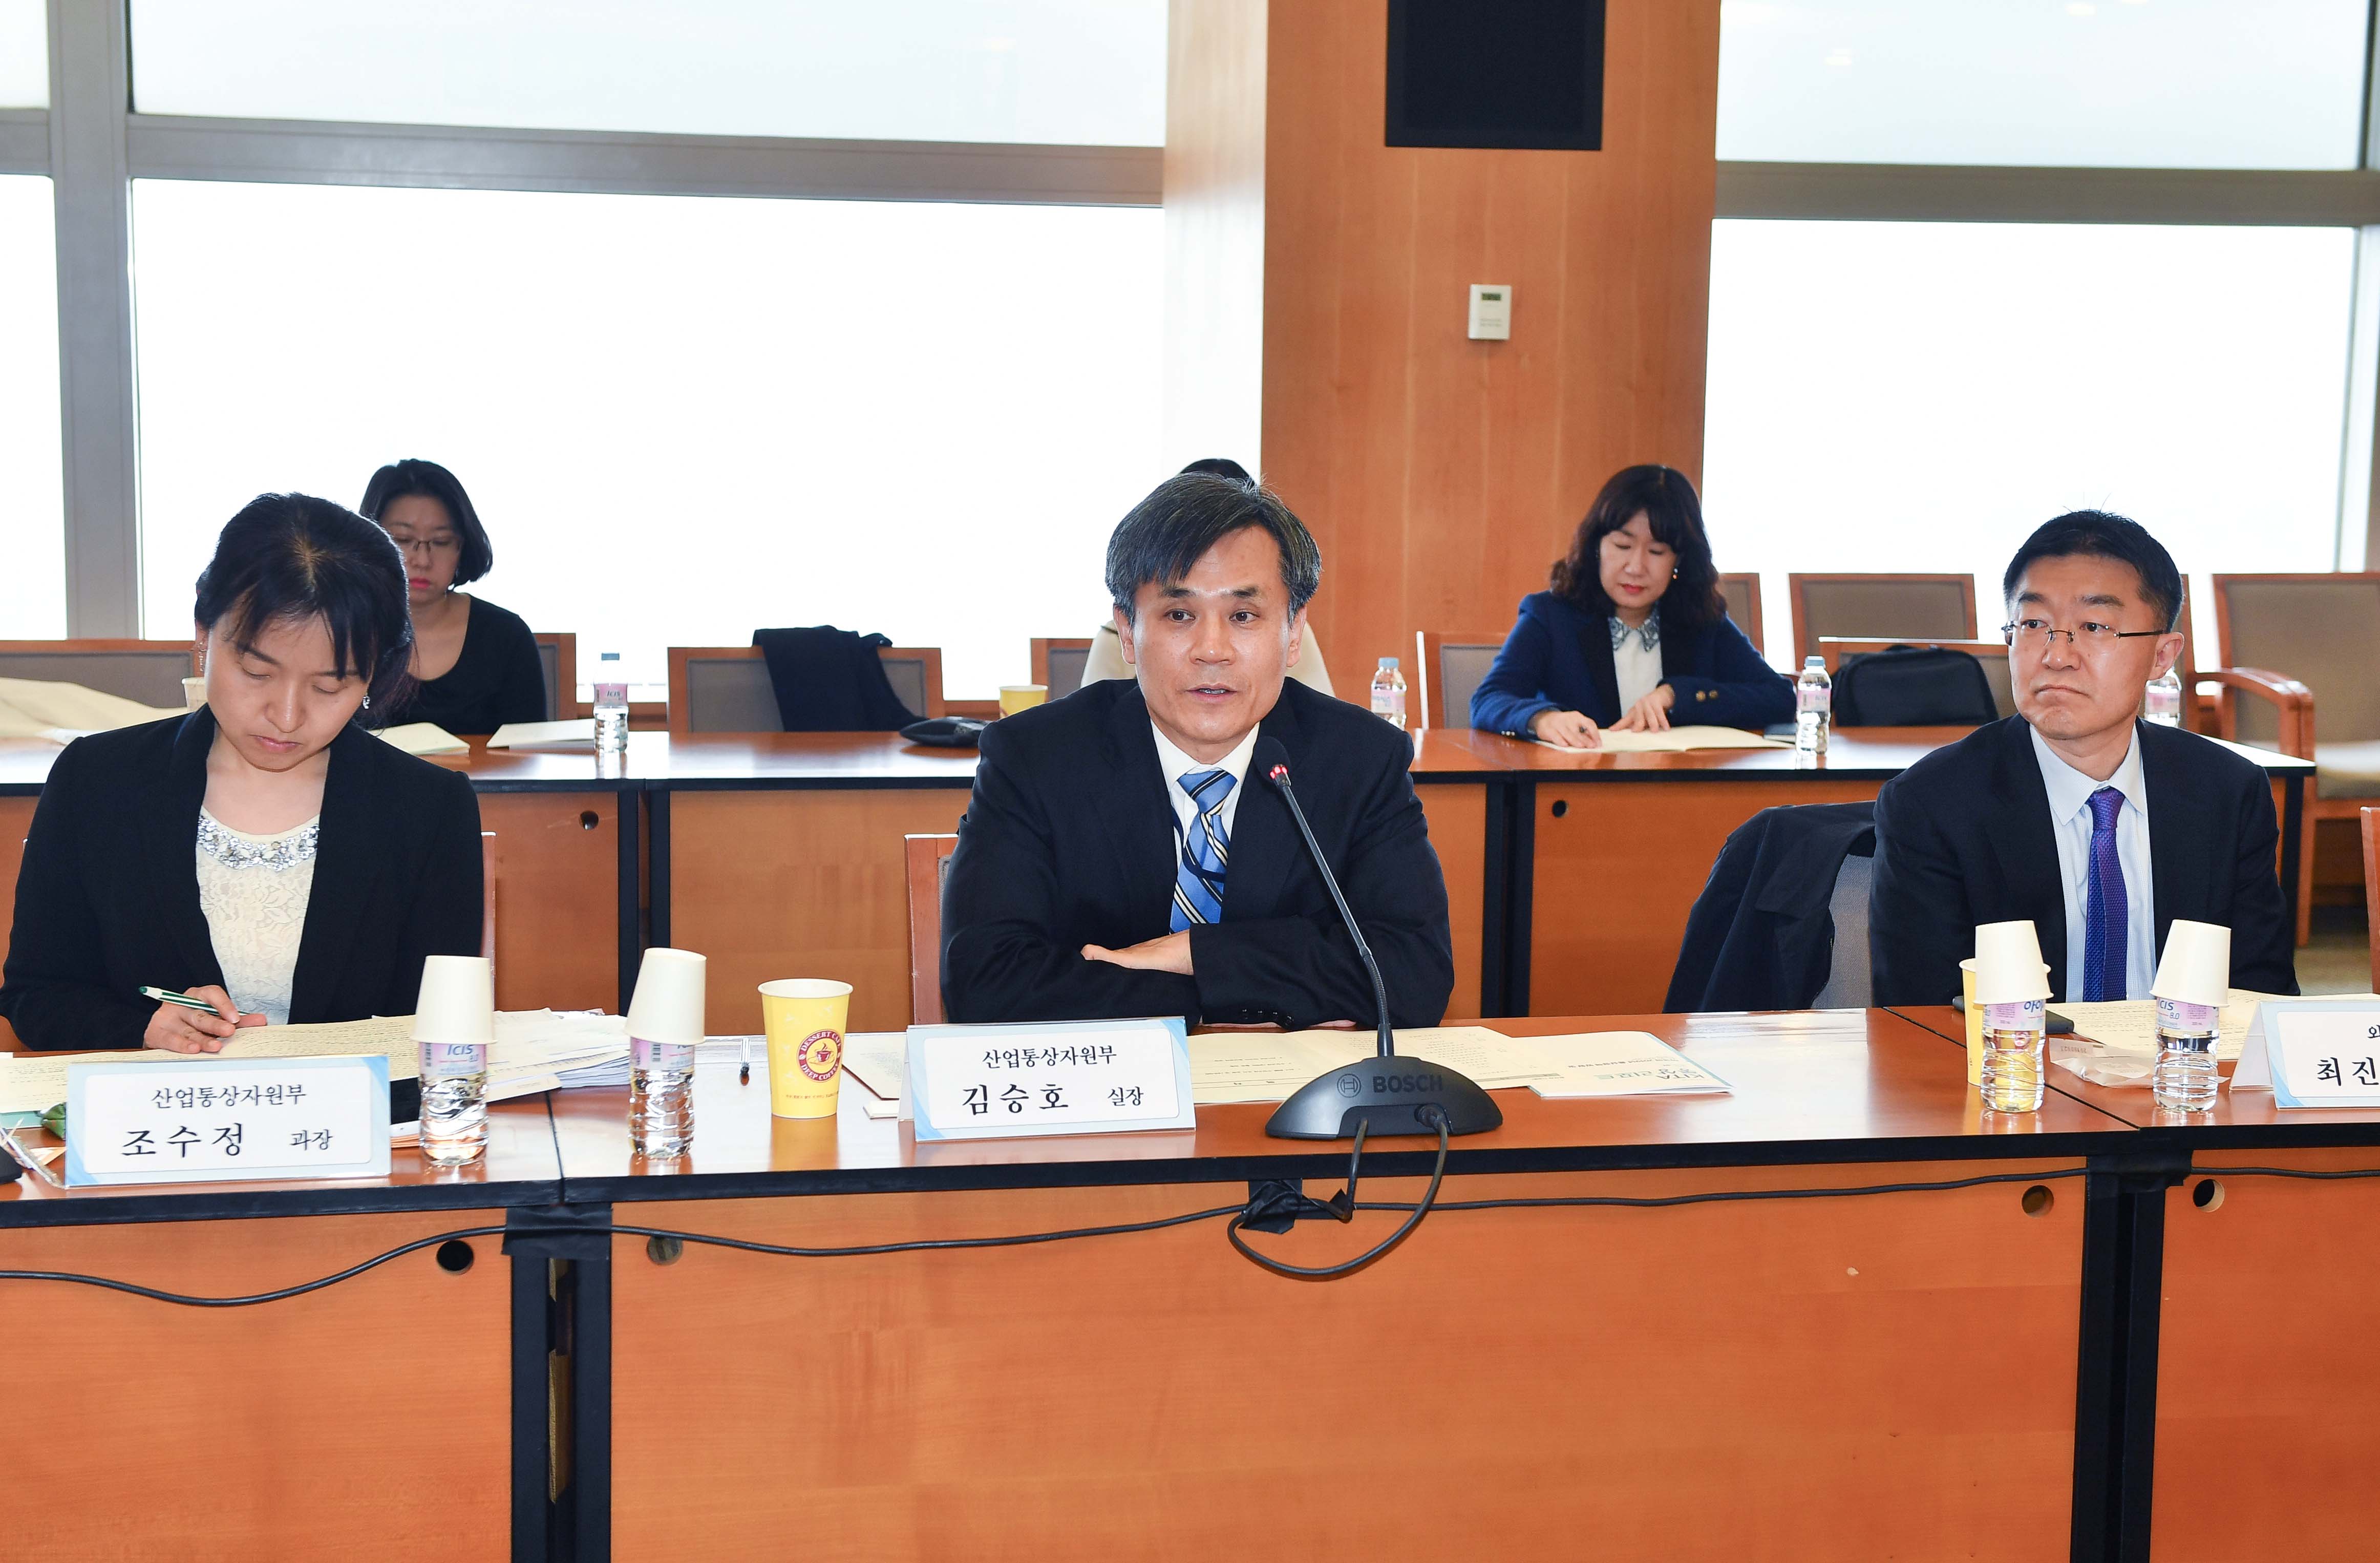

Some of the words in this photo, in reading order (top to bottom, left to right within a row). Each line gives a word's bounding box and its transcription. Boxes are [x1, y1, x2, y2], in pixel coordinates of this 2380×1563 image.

[800, 1031, 832, 1051] DESSERT
[982, 1045, 1117, 1069] 산업통상자원부
[801, 1064, 818, 1079] DEEP
[1373, 1074, 1443, 1093] BOSCH
[2317, 1057, 2379, 1086] 최진
[151, 1084, 306, 1108] 산업통상자원부
[962, 1083, 1069, 1115] 김승호
[1108, 1086, 1144, 1106] 실장
[120, 1123, 243, 1158] 조수정
[289, 1129, 333, 1151] 과장
